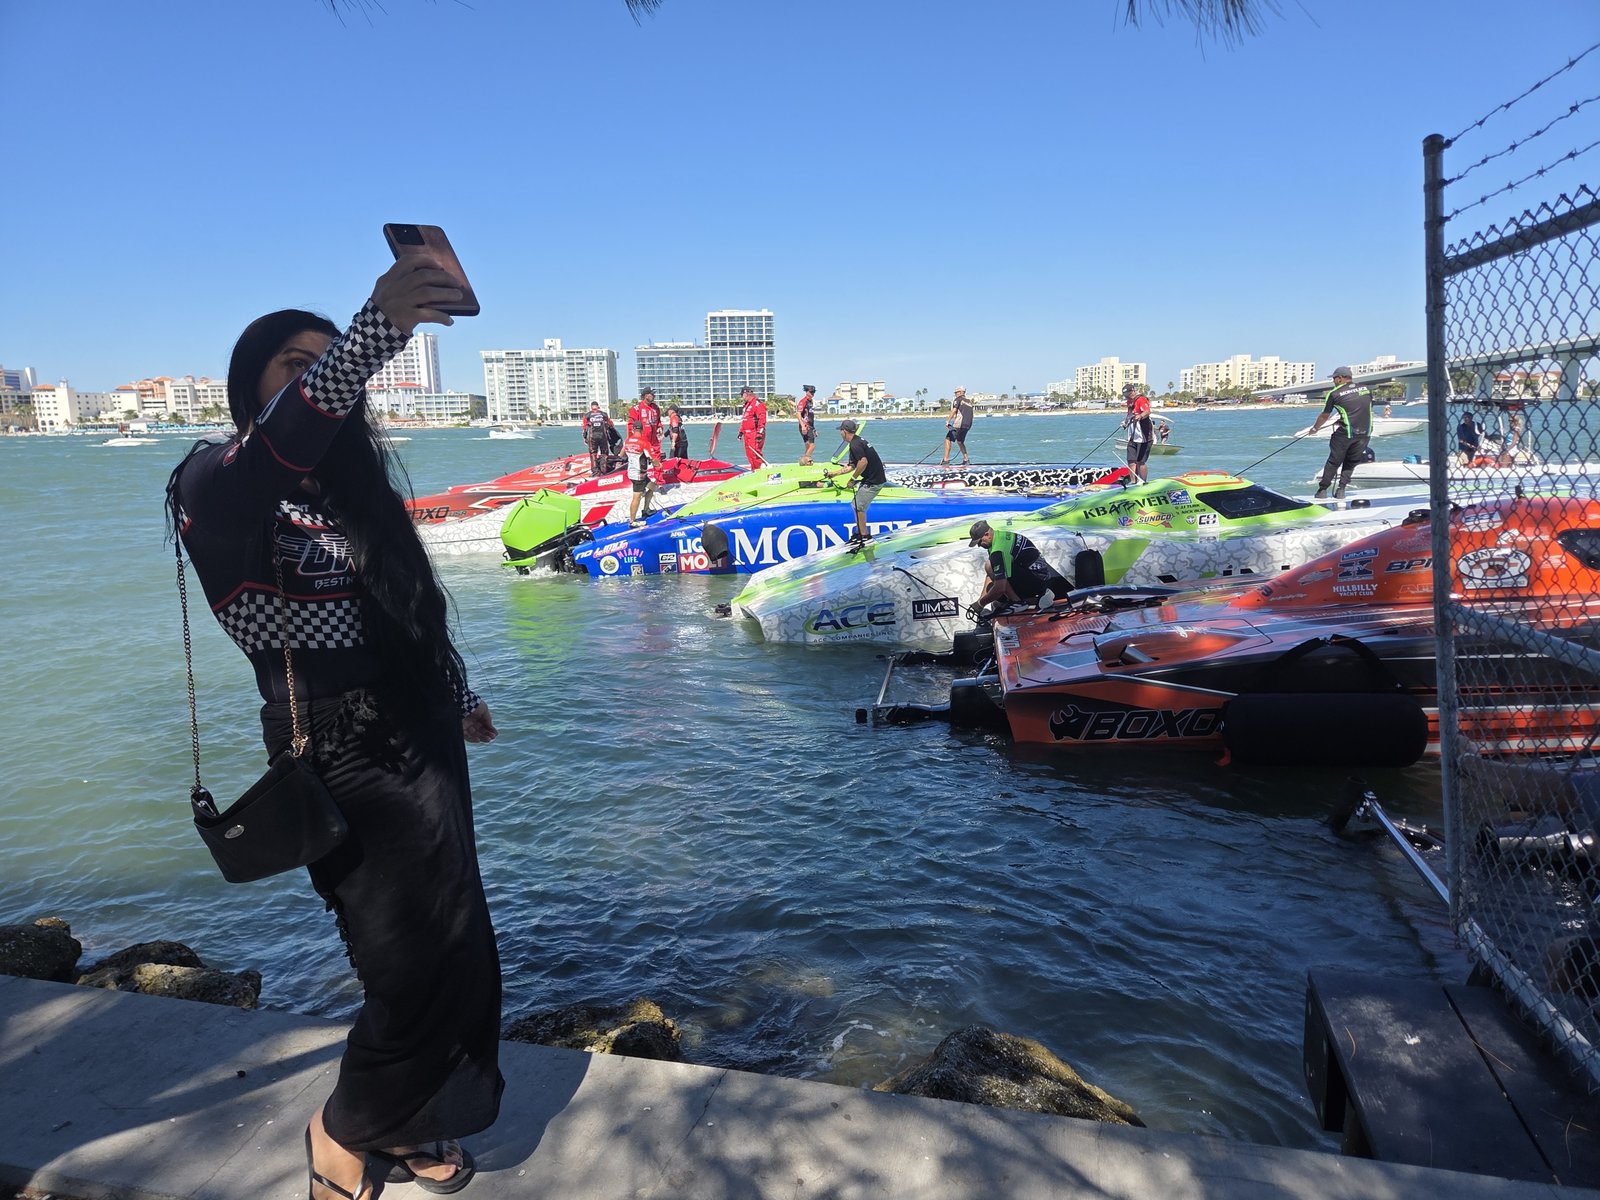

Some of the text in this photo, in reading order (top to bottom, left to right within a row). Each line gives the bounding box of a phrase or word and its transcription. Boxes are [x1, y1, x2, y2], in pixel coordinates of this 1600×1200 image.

[1138, 514, 1172, 523] SUNOCO
[617, 548, 644, 559] MIAMI
[1333, 584, 1378, 593] HILLBILLY
[915, 602, 941, 614] UIM
[812, 602, 896, 631] ACE
